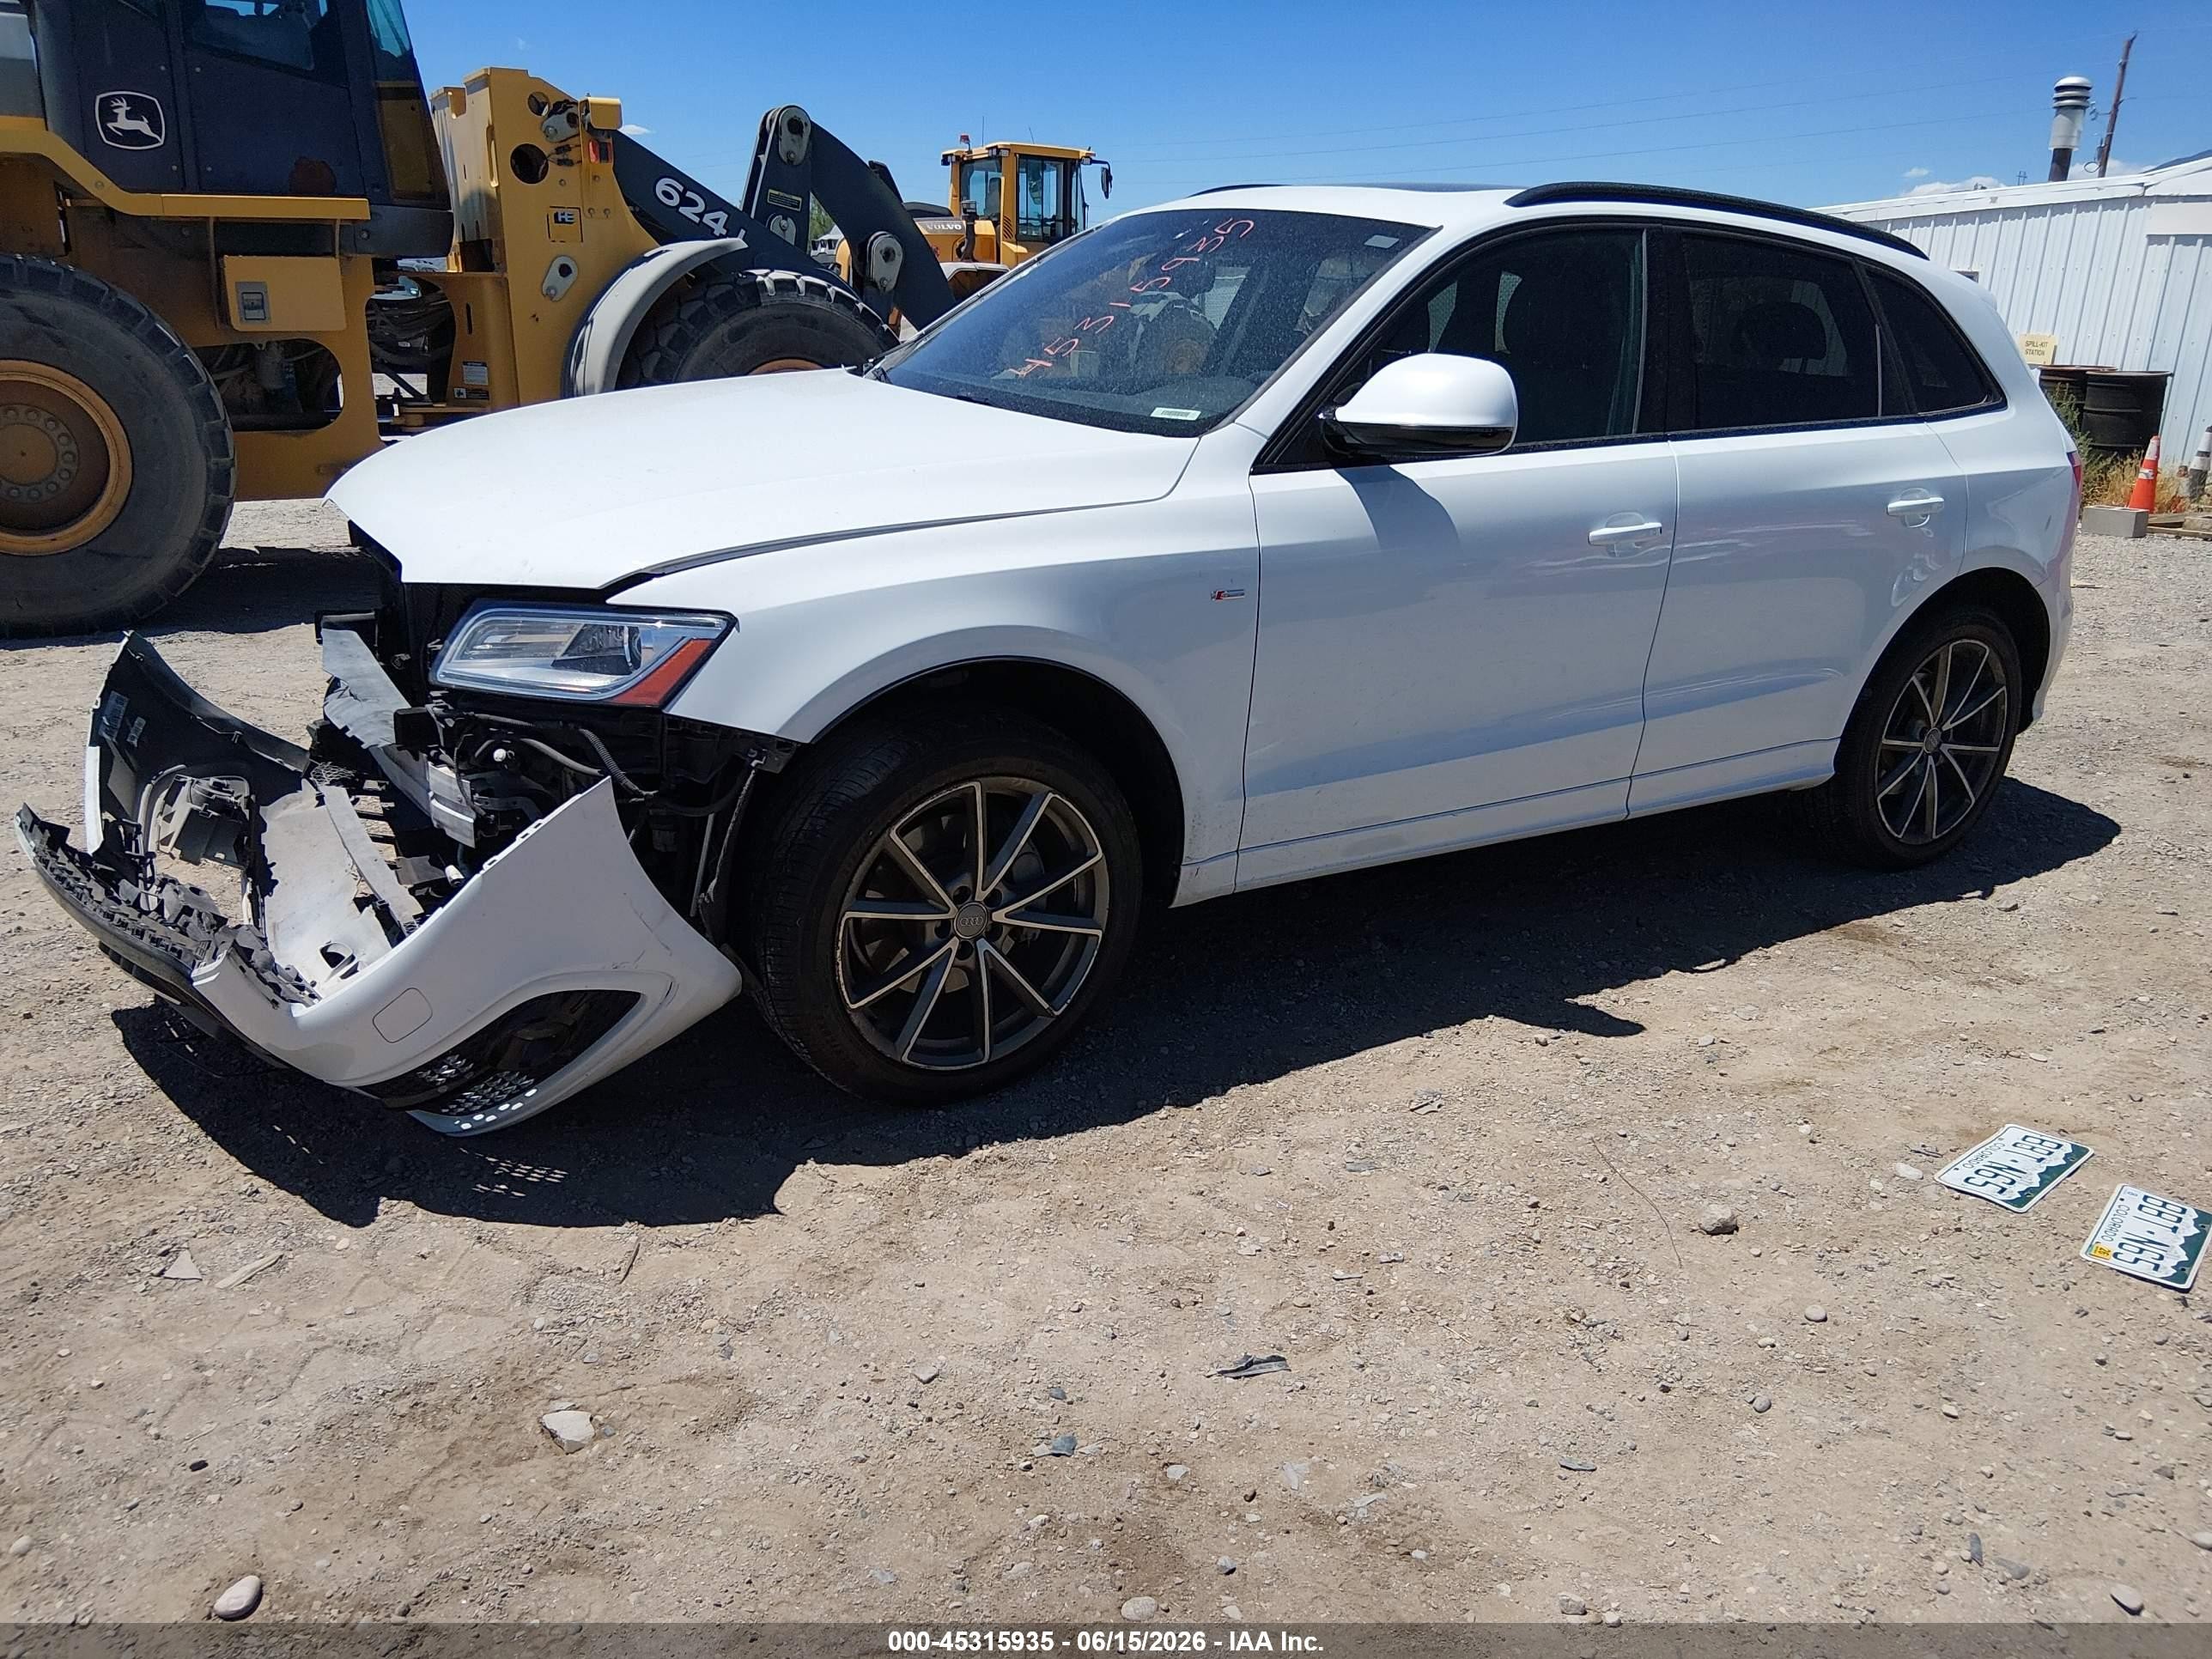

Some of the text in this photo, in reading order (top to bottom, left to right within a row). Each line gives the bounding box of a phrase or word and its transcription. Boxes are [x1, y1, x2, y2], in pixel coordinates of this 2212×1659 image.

[655, 178, 746, 240] 624
[1962, 1142, 2006, 1170] COLORADO
[2100, 1204, 2130, 1243] COLORADO
